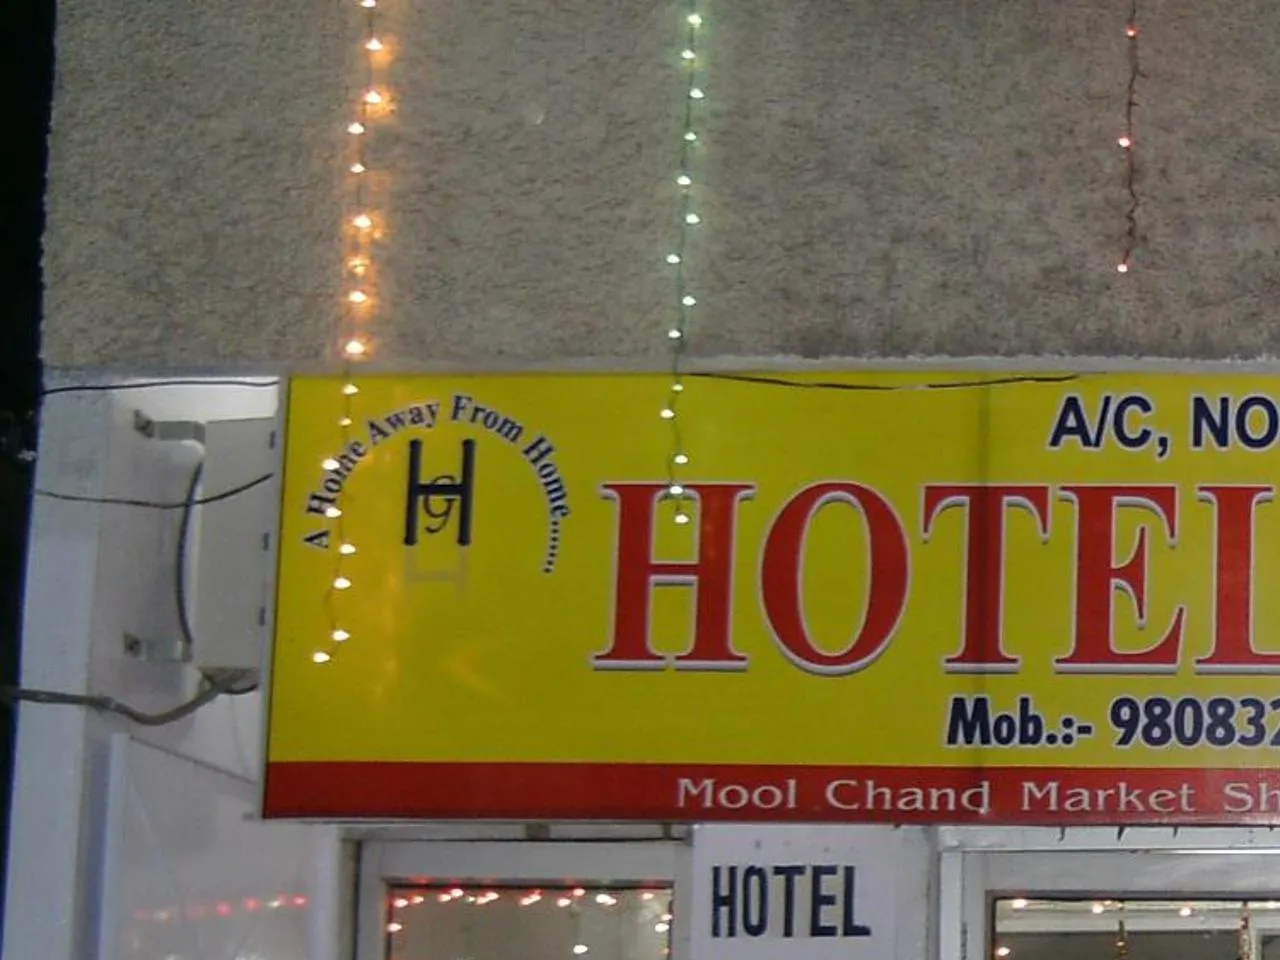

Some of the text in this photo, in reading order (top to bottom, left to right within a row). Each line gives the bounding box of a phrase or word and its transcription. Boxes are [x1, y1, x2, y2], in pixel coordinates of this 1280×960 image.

[1048, 394, 1169, 459] A/C,
[303, 529, 331, 549] A
[366, 401, 441, 445] Away
[451, 394, 527, 444] From
[676, 778, 797, 810] Mool
[824, 779, 991, 813] Chand
[1021, 780, 1198, 813] Market
[710, 864, 872, 938] HOTEL
